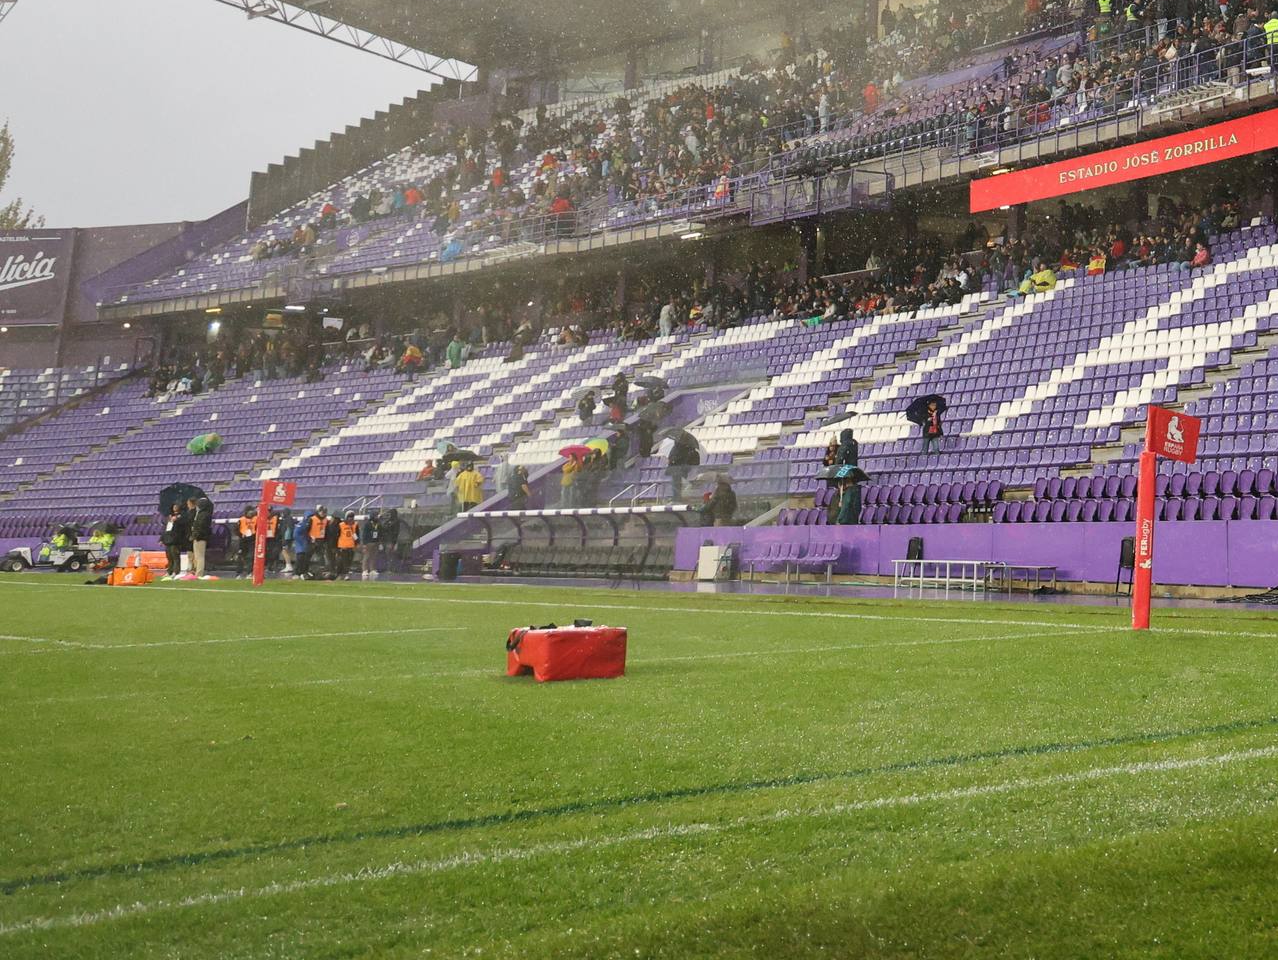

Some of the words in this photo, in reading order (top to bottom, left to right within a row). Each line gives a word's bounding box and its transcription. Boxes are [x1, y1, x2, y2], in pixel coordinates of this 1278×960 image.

[1058, 161, 1119, 184] ESTADIO
[1122, 150, 1160, 170] JOSÉ
[1164, 133, 1239, 160] ZORRILLA
[0, 251, 57, 283] licia
[1140, 518, 1151, 556] FERugby
